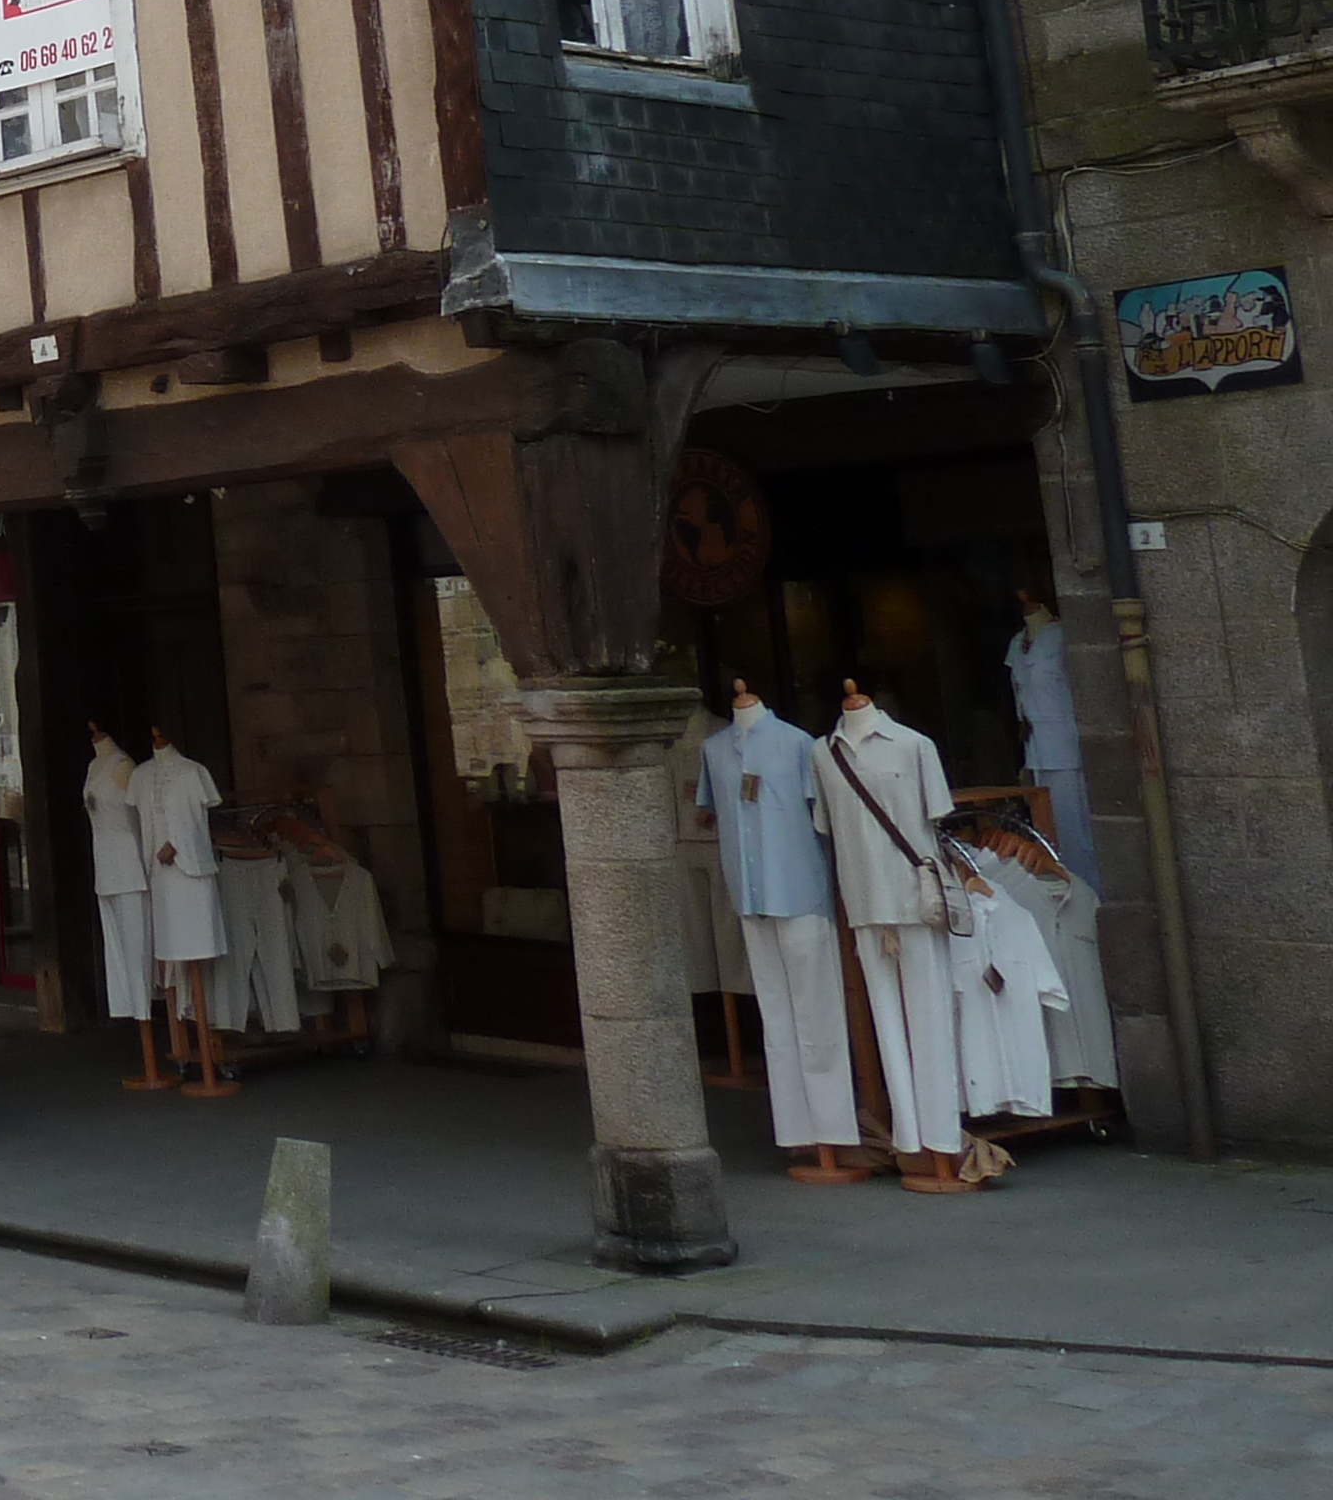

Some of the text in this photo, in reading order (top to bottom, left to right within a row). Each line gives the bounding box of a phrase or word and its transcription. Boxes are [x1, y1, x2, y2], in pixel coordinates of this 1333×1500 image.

[20, 48, 37, 72] 06
[41, 42, 57, 67] 68
[61, 38, 77, 61] 40
[81, 31, 98, 56] 62
[1179, 330, 1280, 367] L'APPORT
